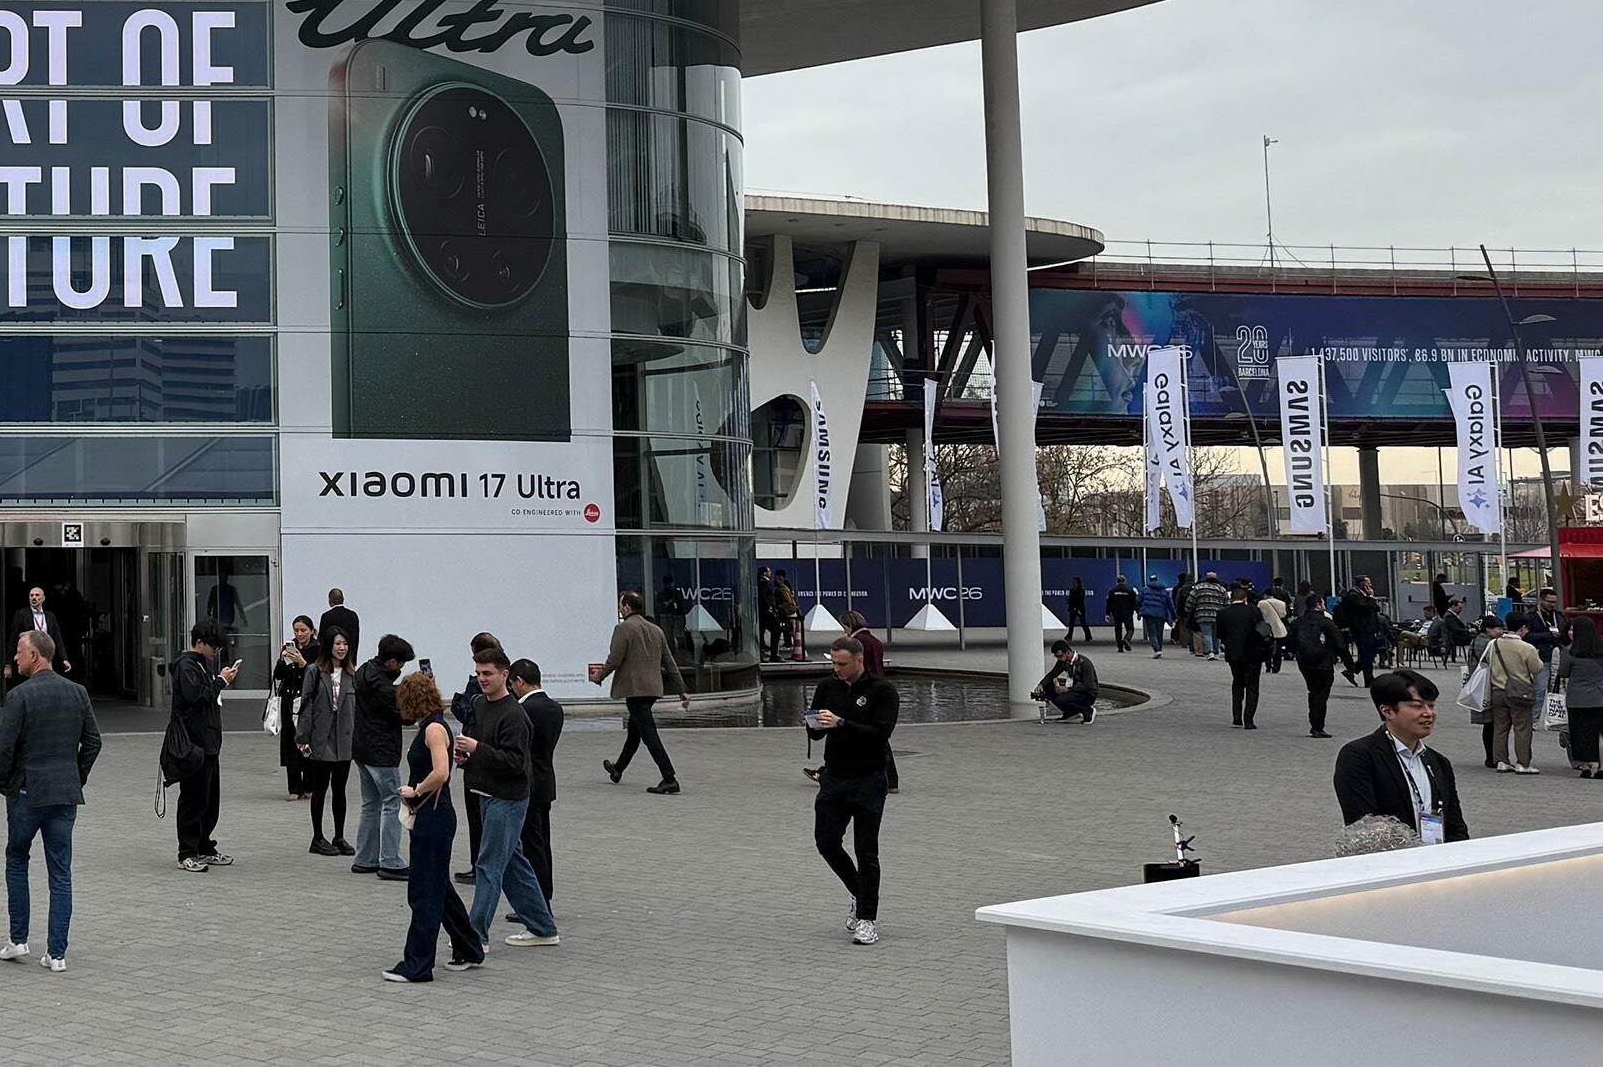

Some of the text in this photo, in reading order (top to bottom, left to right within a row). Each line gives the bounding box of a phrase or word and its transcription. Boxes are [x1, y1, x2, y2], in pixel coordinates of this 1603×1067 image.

[121, 8, 236, 147] OF
[1440, 349, 1454, 362] BN
[1457, 349, 1468, 362] IN
[1526, 349, 1573, 363] ACTIVITY.
[1238, 367, 1270, 377] BARCELONA
[478, 473, 506, 499] 17
[517, 473, 581, 500] Ultra
[909, 586, 983, 600] MWC26
